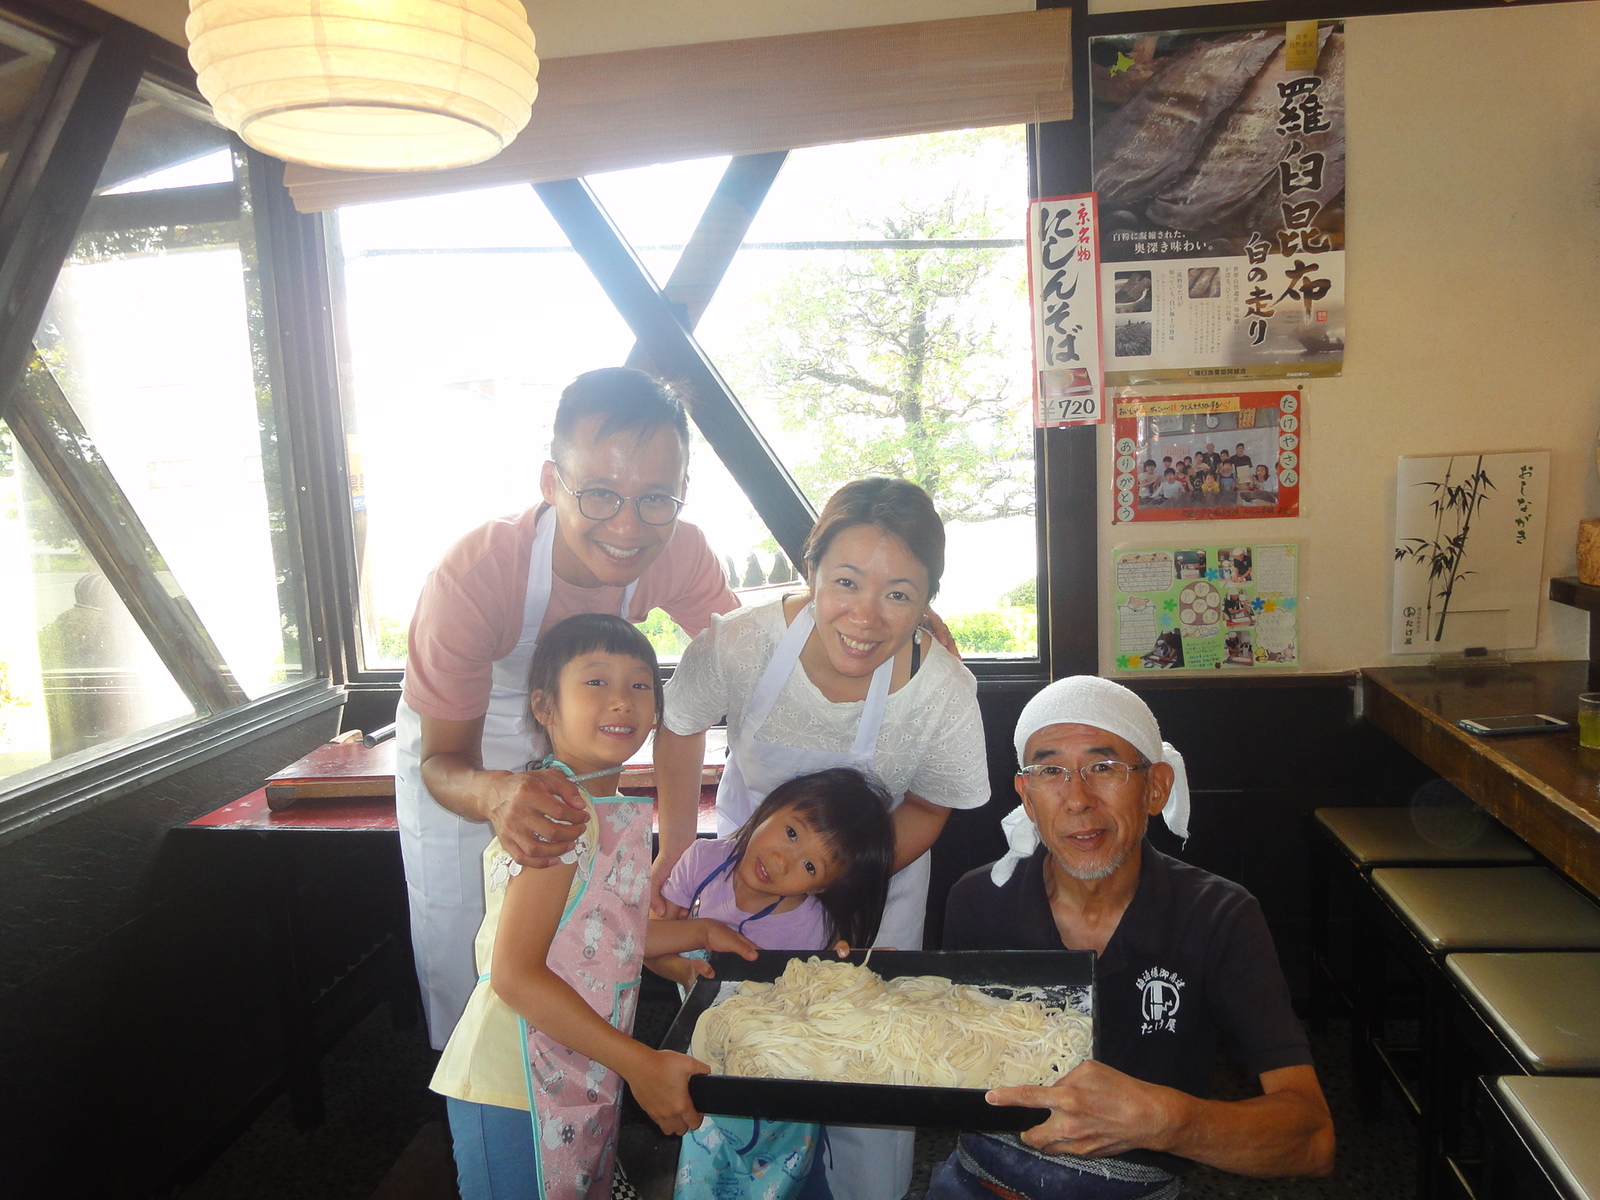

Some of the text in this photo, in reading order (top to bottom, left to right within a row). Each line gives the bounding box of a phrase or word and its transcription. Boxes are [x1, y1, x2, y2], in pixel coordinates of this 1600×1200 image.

[1075, 203, 1091, 262] 京名物
[1276, 77, 1332, 324] 羅臼昆布
[1041, 207, 1082, 366] にしんそば
[1134, 240, 1213, 255] 奥深き味わい。
[1244, 233, 1275, 346] 白の走り
[1120, 440, 1134, 519] ありがとう
[1282, 397, 1296, 484] たけやさん
[1515, 465, 1533, 545] おしながき
[1141, 1018, 1177, 1036] たけ屋
